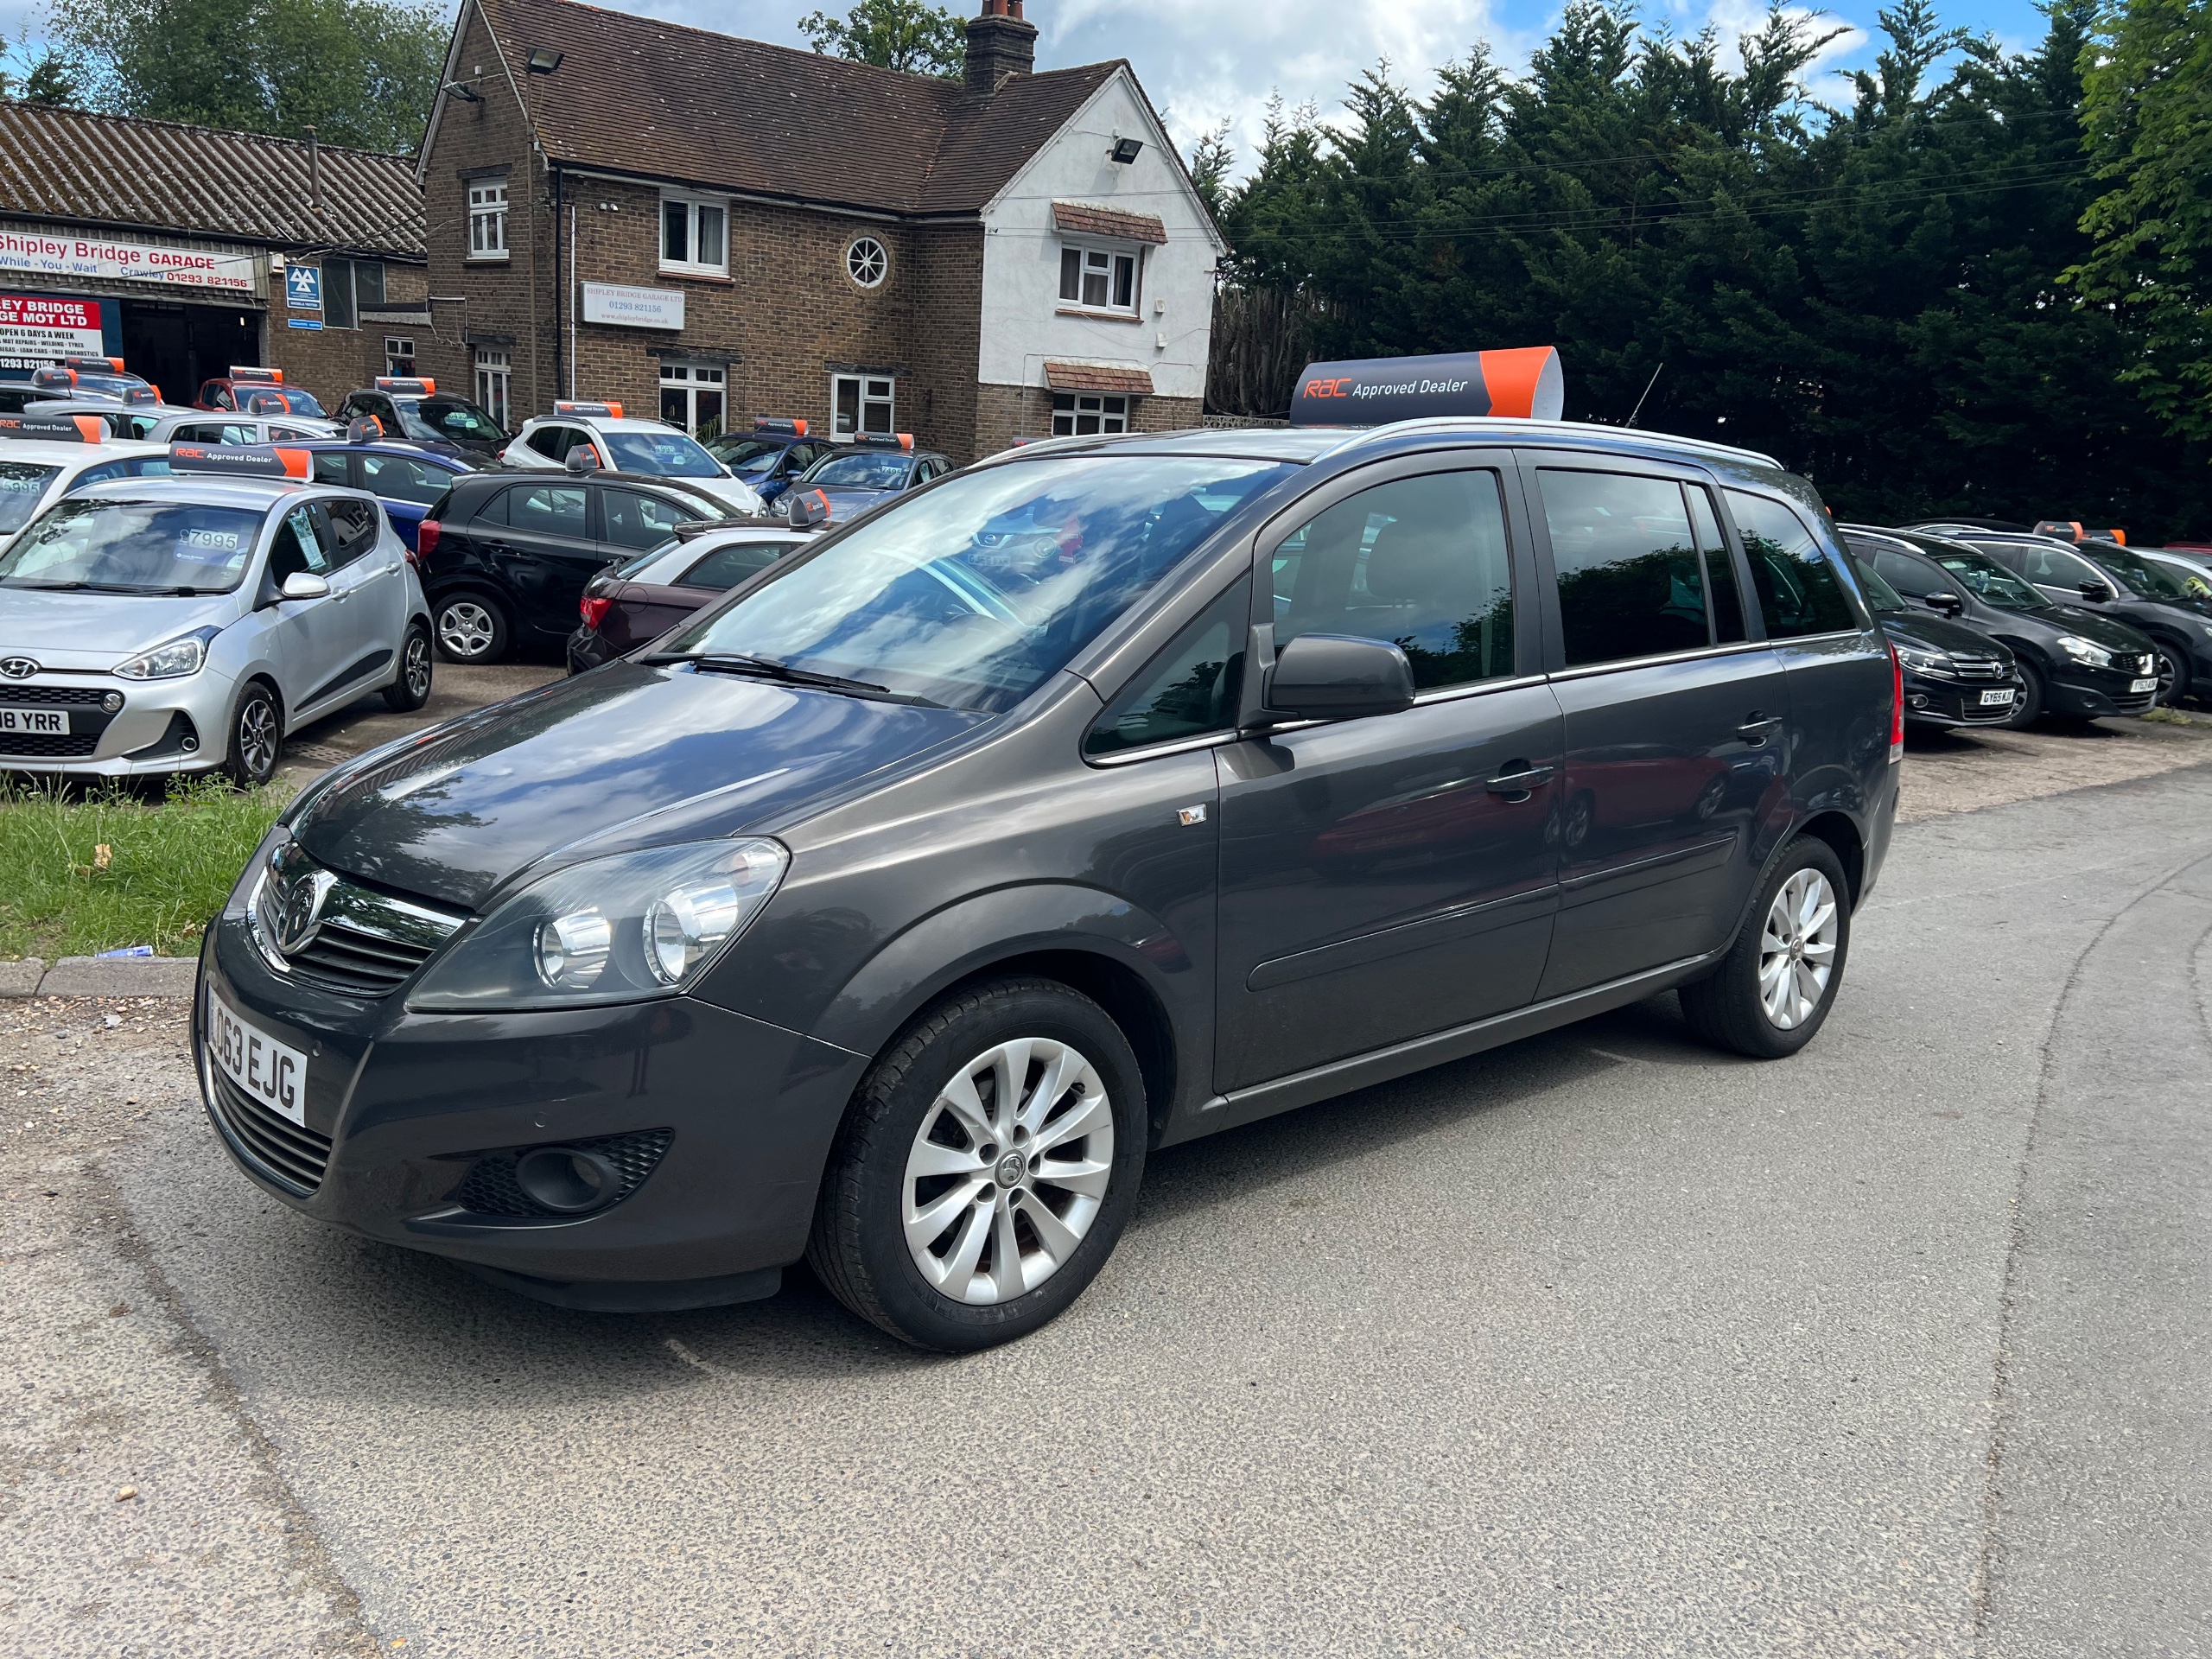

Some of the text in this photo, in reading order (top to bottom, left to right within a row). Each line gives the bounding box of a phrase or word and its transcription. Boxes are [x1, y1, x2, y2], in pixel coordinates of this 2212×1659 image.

[0, 235, 215, 270] Shipley Bridge GARAGE
[0, 256, 30, 268] While
[41, 259, 62, 270] You
[72, 262, 98, 273] Wait
[120, 266, 247, 288] Crawley 01293 821156
[586, 288, 615, 296] SHIPLEY
[616, 290, 641, 299] BRIDGE
[642, 293, 669, 302] GARAGE
[0, 299, 85, 315] EY BRIDGE
[608, 301, 662, 313] 01293 821156
[22, 312, 55, 324] MOT
[60, 315, 87, 326] LTD
[601, 313, 669, 324] www.shipleybridge.co.uk
[0, 327, 18, 336] OPEN
[28, 329, 47, 338] DAYS
[54, 331, 75, 340] WEEK
[23, 359, 56, 369] 821156
[1352, 380, 1417, 399] Approved
[1419, 378, 1468, 393] Dealer
[22, 423, 51, 431] Approved
[207, 452, 245, 461] Approved
[245, 454, 272, 463] Dealer
[3, 481, 39, 494] 5995
[21, 712, 61, 731] YRR
[248, 1034, 295, 1109] EJG
